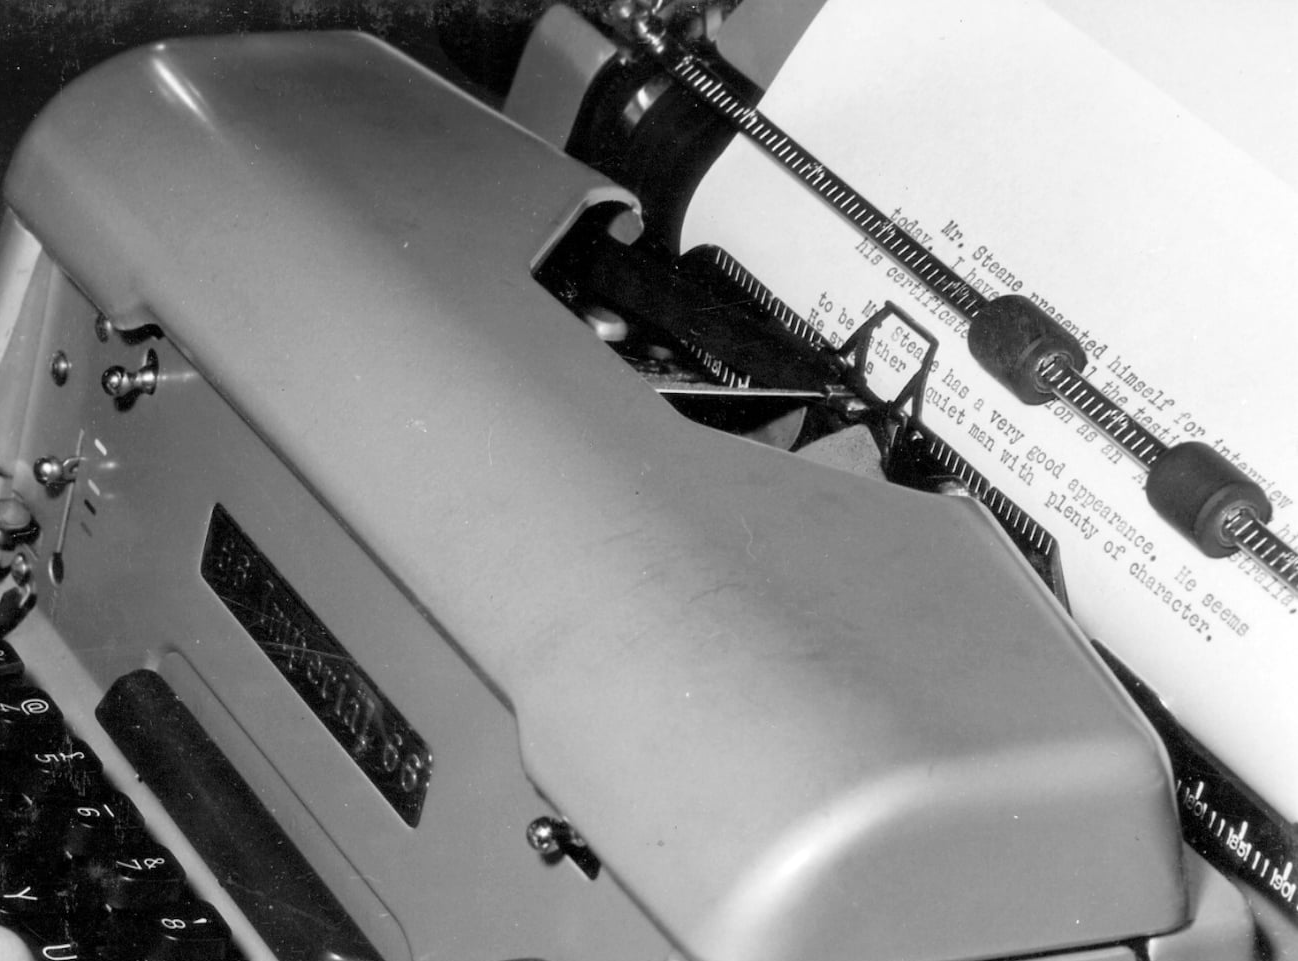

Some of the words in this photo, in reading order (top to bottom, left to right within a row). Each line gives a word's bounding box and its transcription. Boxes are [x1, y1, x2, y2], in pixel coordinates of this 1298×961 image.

[855, 237, 883, 266] his
[964, 267, 1001, 301] have
[807, 308, 825, 332] He
[941, 220, 965, 248] Mr.
[972, 245, 1024, 292] Steane
[1107, 355, 1175, 412] himself
[1173, 411, 1206, 442] for
[1101, 381, 1129, 406] the
[1076, 423, 1098, 444] as
[1101, 443, 1125, 465] an
[818, 291, 834, 313] to
[838, 306, 856, 330] be
[867, 335, 907, 373] ather
[924, 383, 965, 426] quiet
[968, 419, 996, 452] man
[998, 448, 1035, 487] with
[1044, 490, 1100, 541] plenty
[1103, 540, 1127, 561] of
[1129, 561, 1213, 642] character.
[890, 332, 941, 374] Steae
[942, 368, 970, 400] has
[973, 397, 985, 412] a
[989, 409, 1026, 444] very
[1026, 445, 1067, 480] good
[1068, 478, 1157, 562] appearance.
[1173, 565, 1198, 592] He
[1201, 593, 1251, 637] seems
[20, 698, 50, 716] @
[76, 806, 101, 818] 6
[115, 858, 143, 871] 7
[143, 857, 166, 870] &
[2, 886, 39, 901] Y
[160, 917, 187, 930] 8
[41, 943, 78, 961] U
